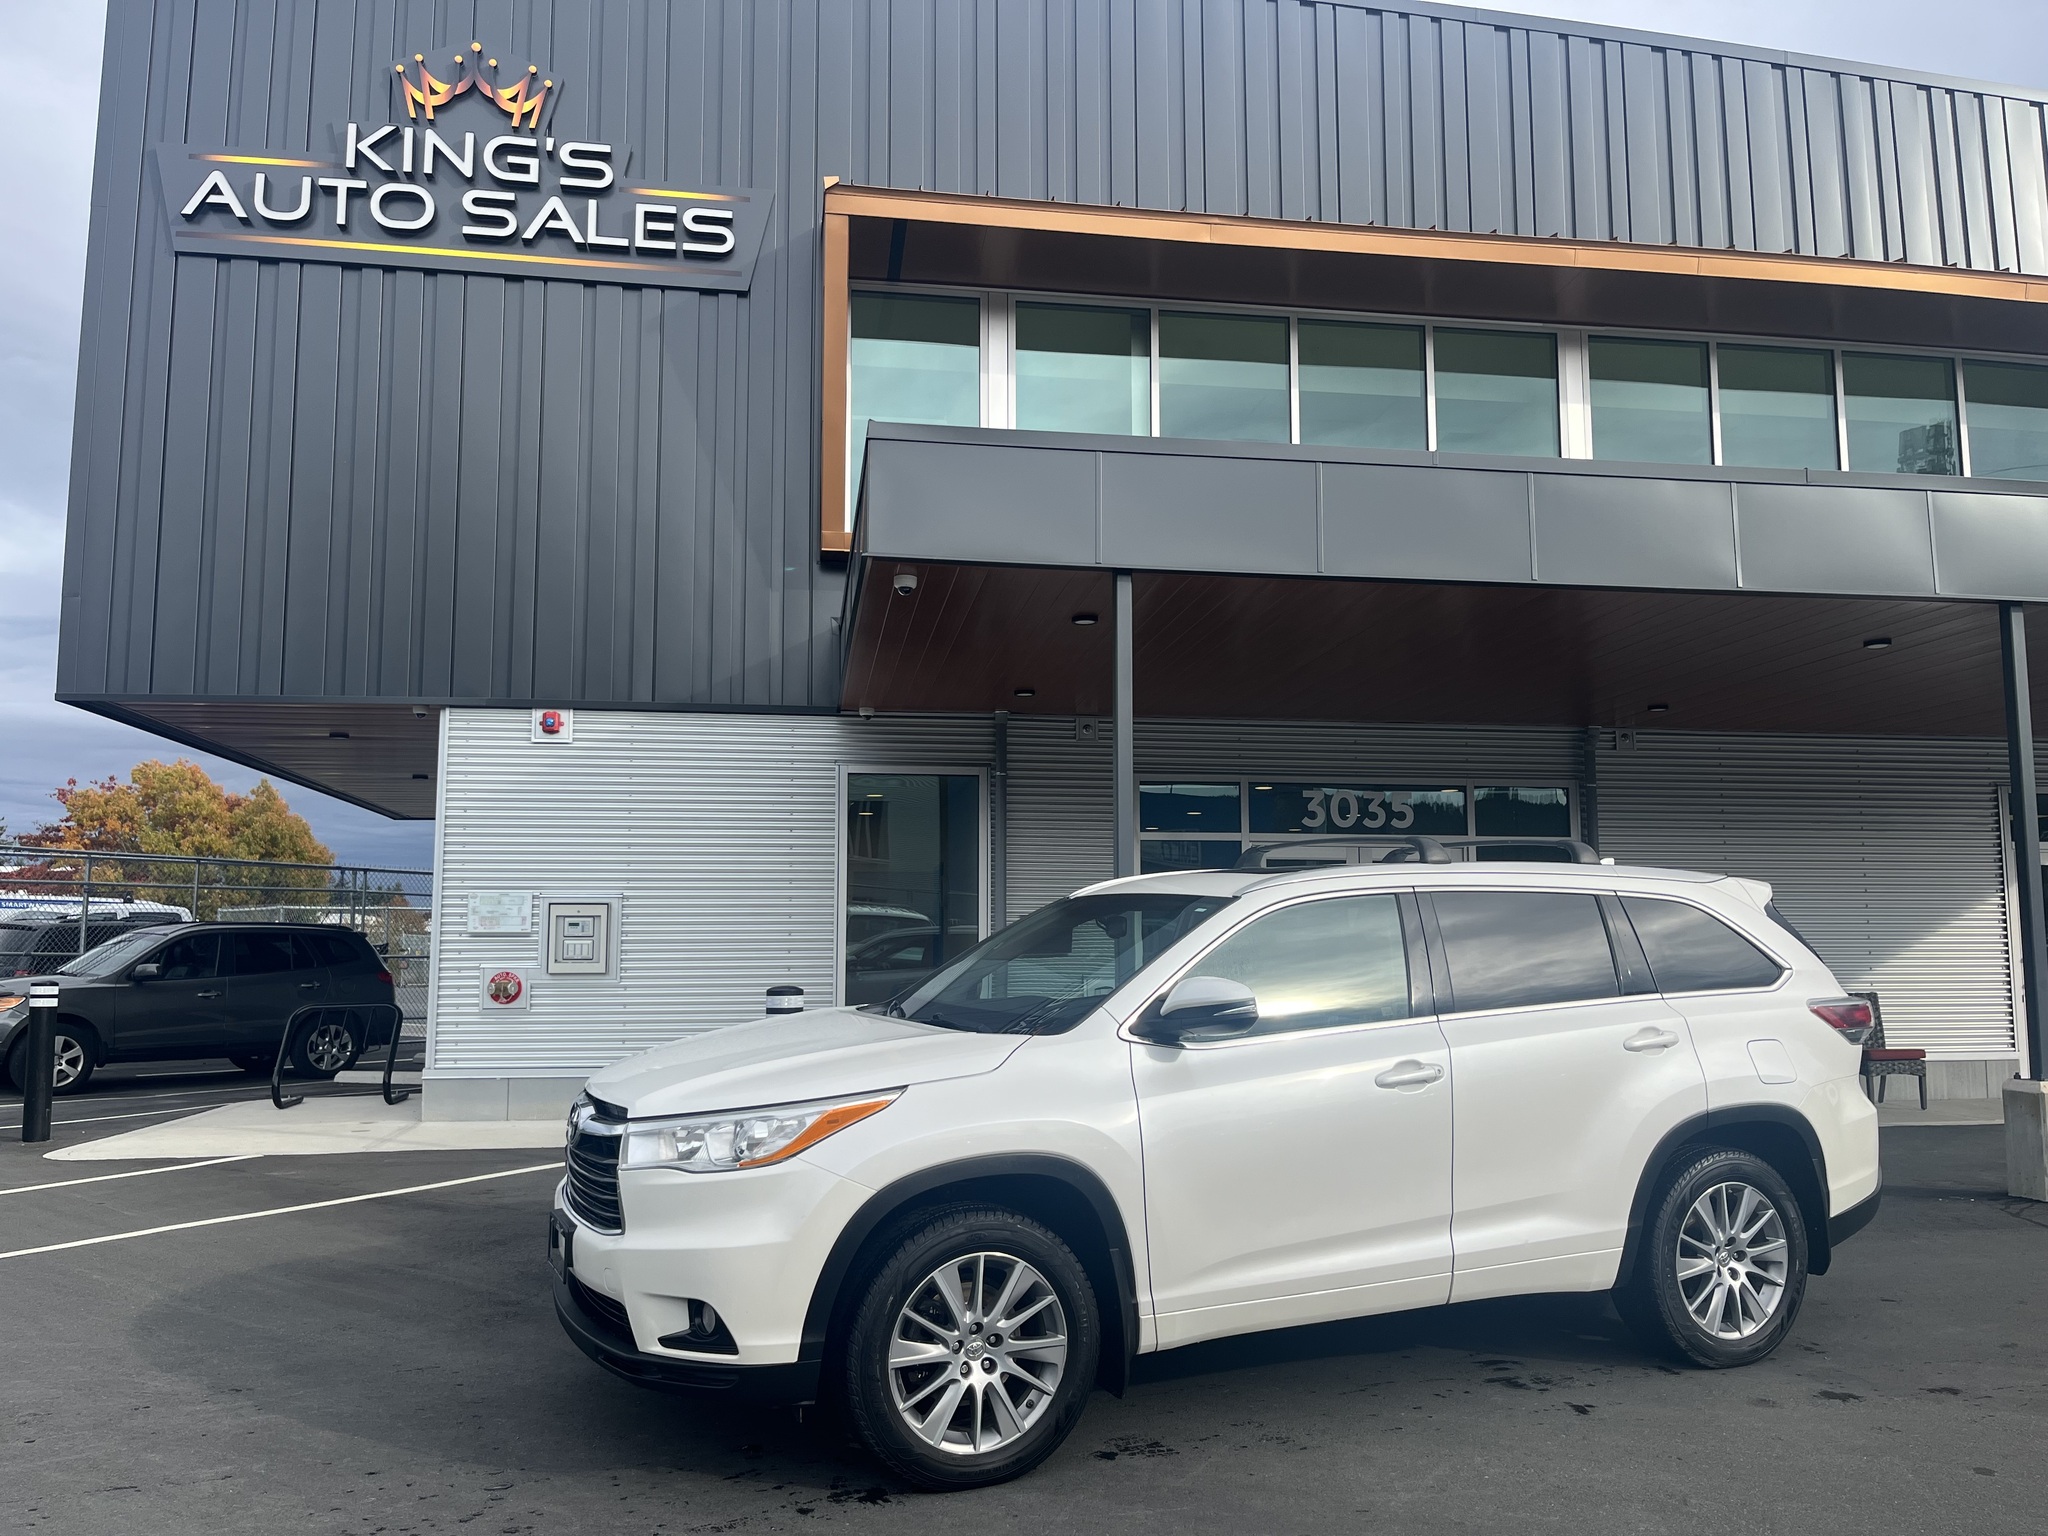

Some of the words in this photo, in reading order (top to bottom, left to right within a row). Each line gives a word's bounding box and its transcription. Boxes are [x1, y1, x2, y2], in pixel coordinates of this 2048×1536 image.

[345, 122, 615, 189] KING'S
[180, 169, 437, 231] AUTO
[461, 188, 736, 255] SALES
[1301, 789, 1415, 829] 3035
